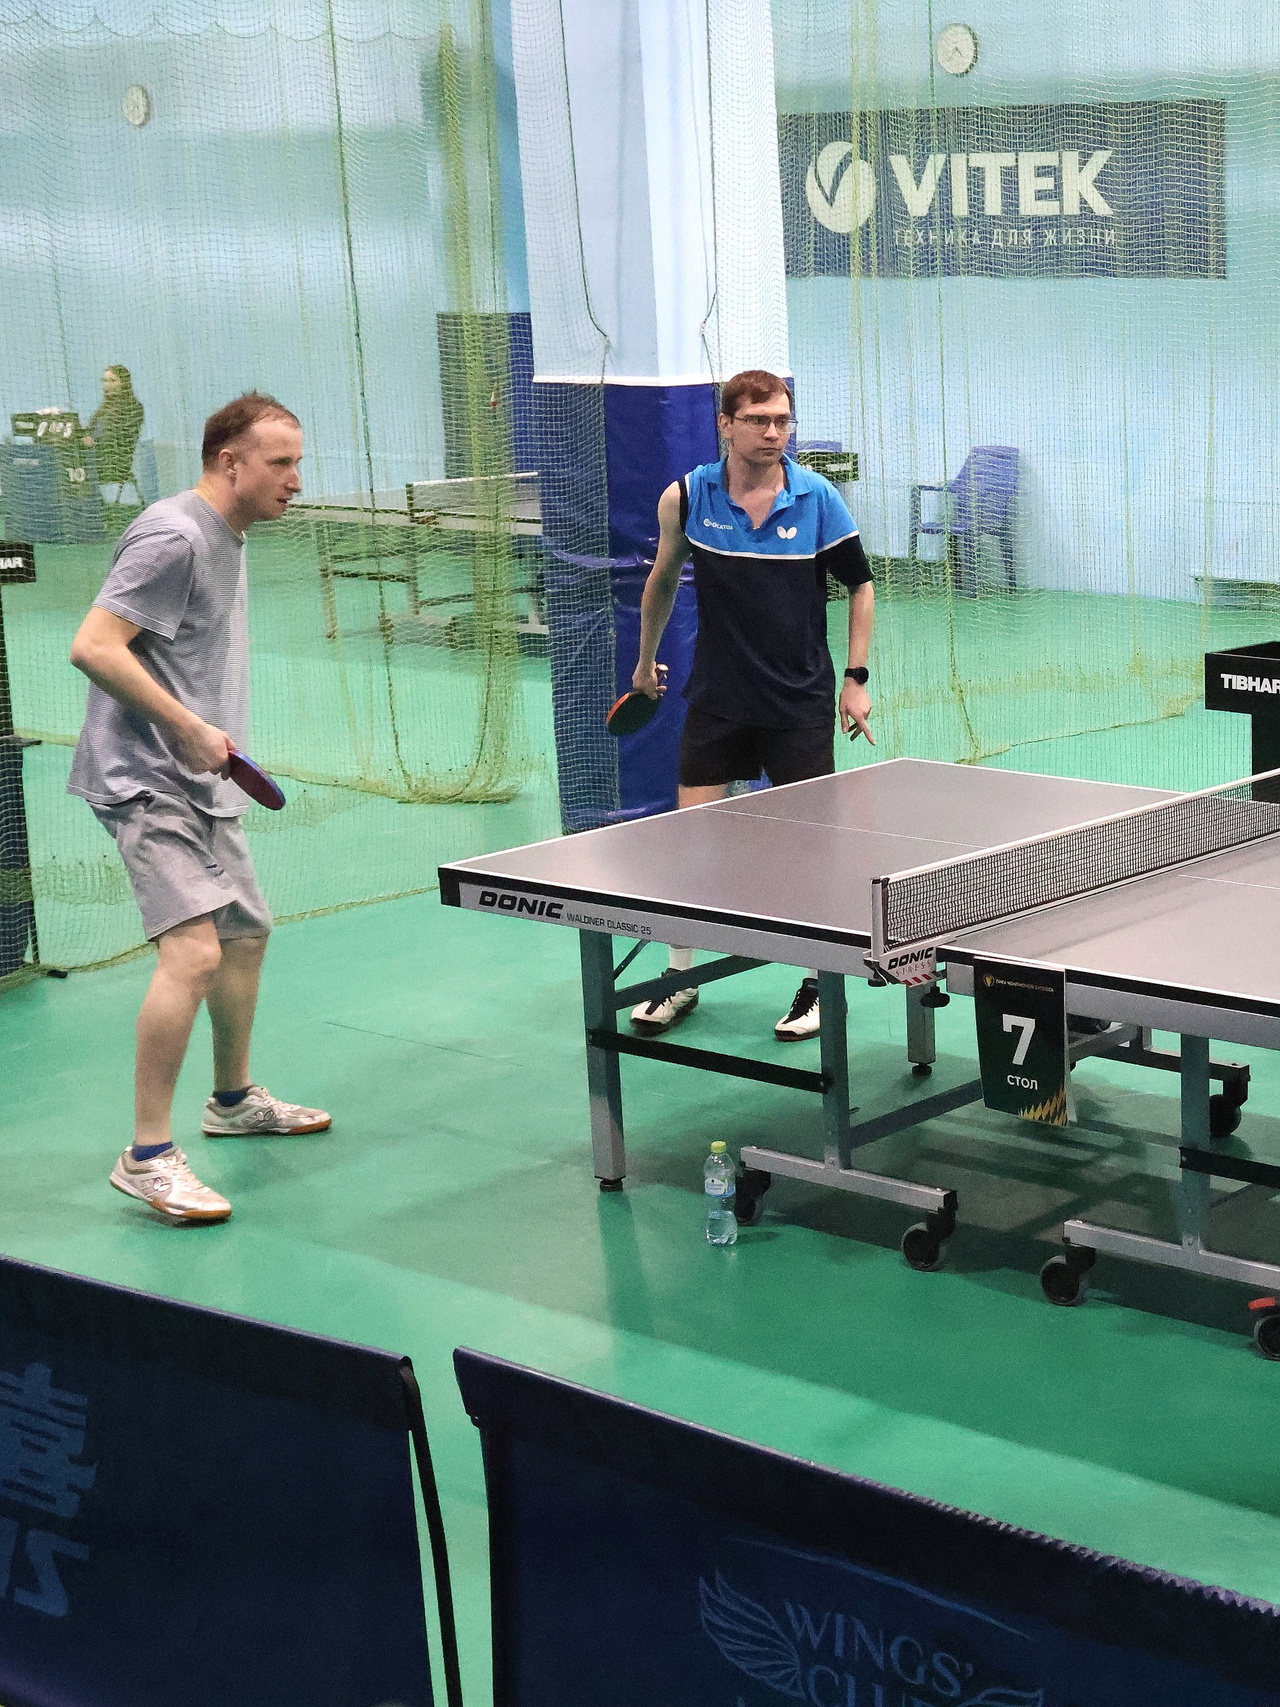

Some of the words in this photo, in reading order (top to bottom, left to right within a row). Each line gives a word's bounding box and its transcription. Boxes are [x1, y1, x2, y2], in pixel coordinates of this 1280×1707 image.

[889, 150, 1114, 216] VITEK
[894, 229, 981, 246] ТЕХНИКА
[991, 228, 1032, 250] ДЛЯ
[1044, 228, 1115, 246] ЖИЗНИ
[478, 890, 564, 919] DONIC
[566, 912, 605, 927] WALDNER
[607, 919, 639, 933] CLASSIC
[640, 926, 652, 936] 25
[887, 946, 934, 970] DONIC
[895, 960, 931, 978] STRESS
[1002, 1013, 1036, 1066] 7
[1006, 1074, 1038, 1091] СТОЛ
